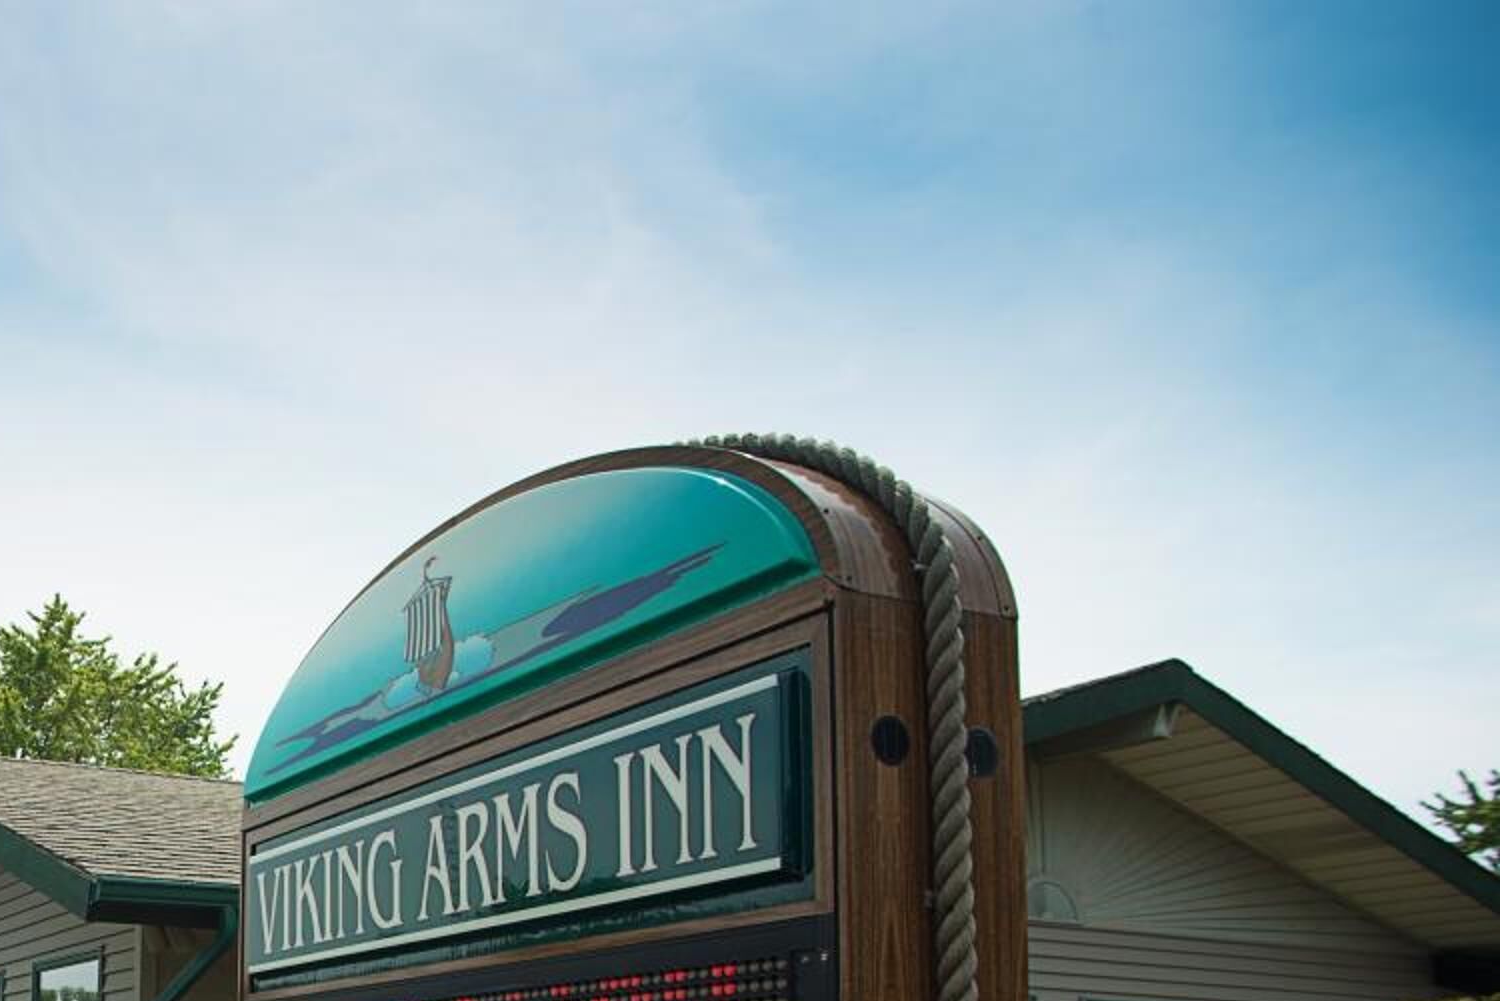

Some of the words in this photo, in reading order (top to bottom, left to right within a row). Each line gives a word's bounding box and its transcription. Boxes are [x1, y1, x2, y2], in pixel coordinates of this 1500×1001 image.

[257, 830, 403, 954] VIKING
[418, 772, 588, 920] ARMS
[614, 713, 757, 877] INN
